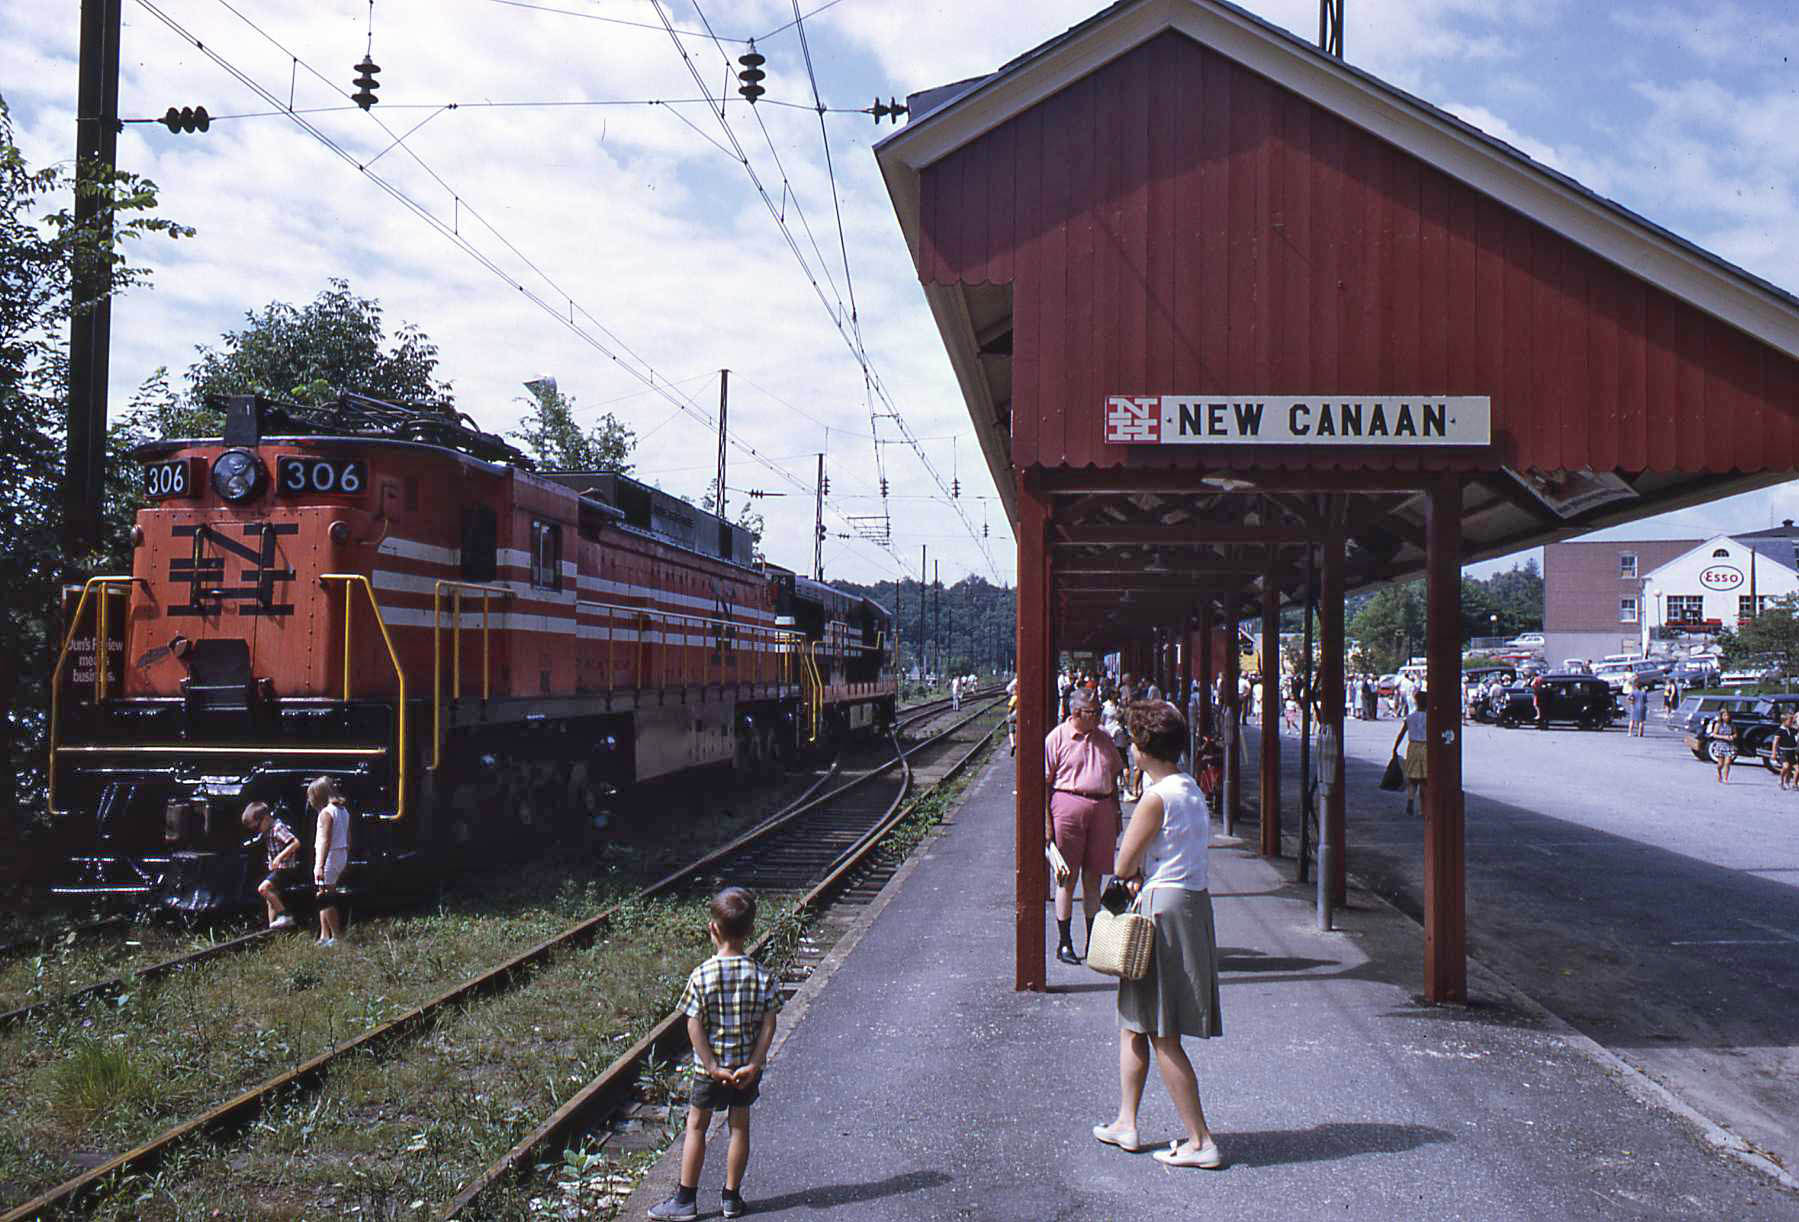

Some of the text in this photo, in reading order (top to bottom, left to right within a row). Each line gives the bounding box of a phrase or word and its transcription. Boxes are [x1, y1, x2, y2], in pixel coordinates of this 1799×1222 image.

[1178, 403, 1447, 437] NEW CANAAN
[148, 465, 184, 495] 306
[287, 462, 360, 491] 306
[1705, 571, 1738, 582] Esso
